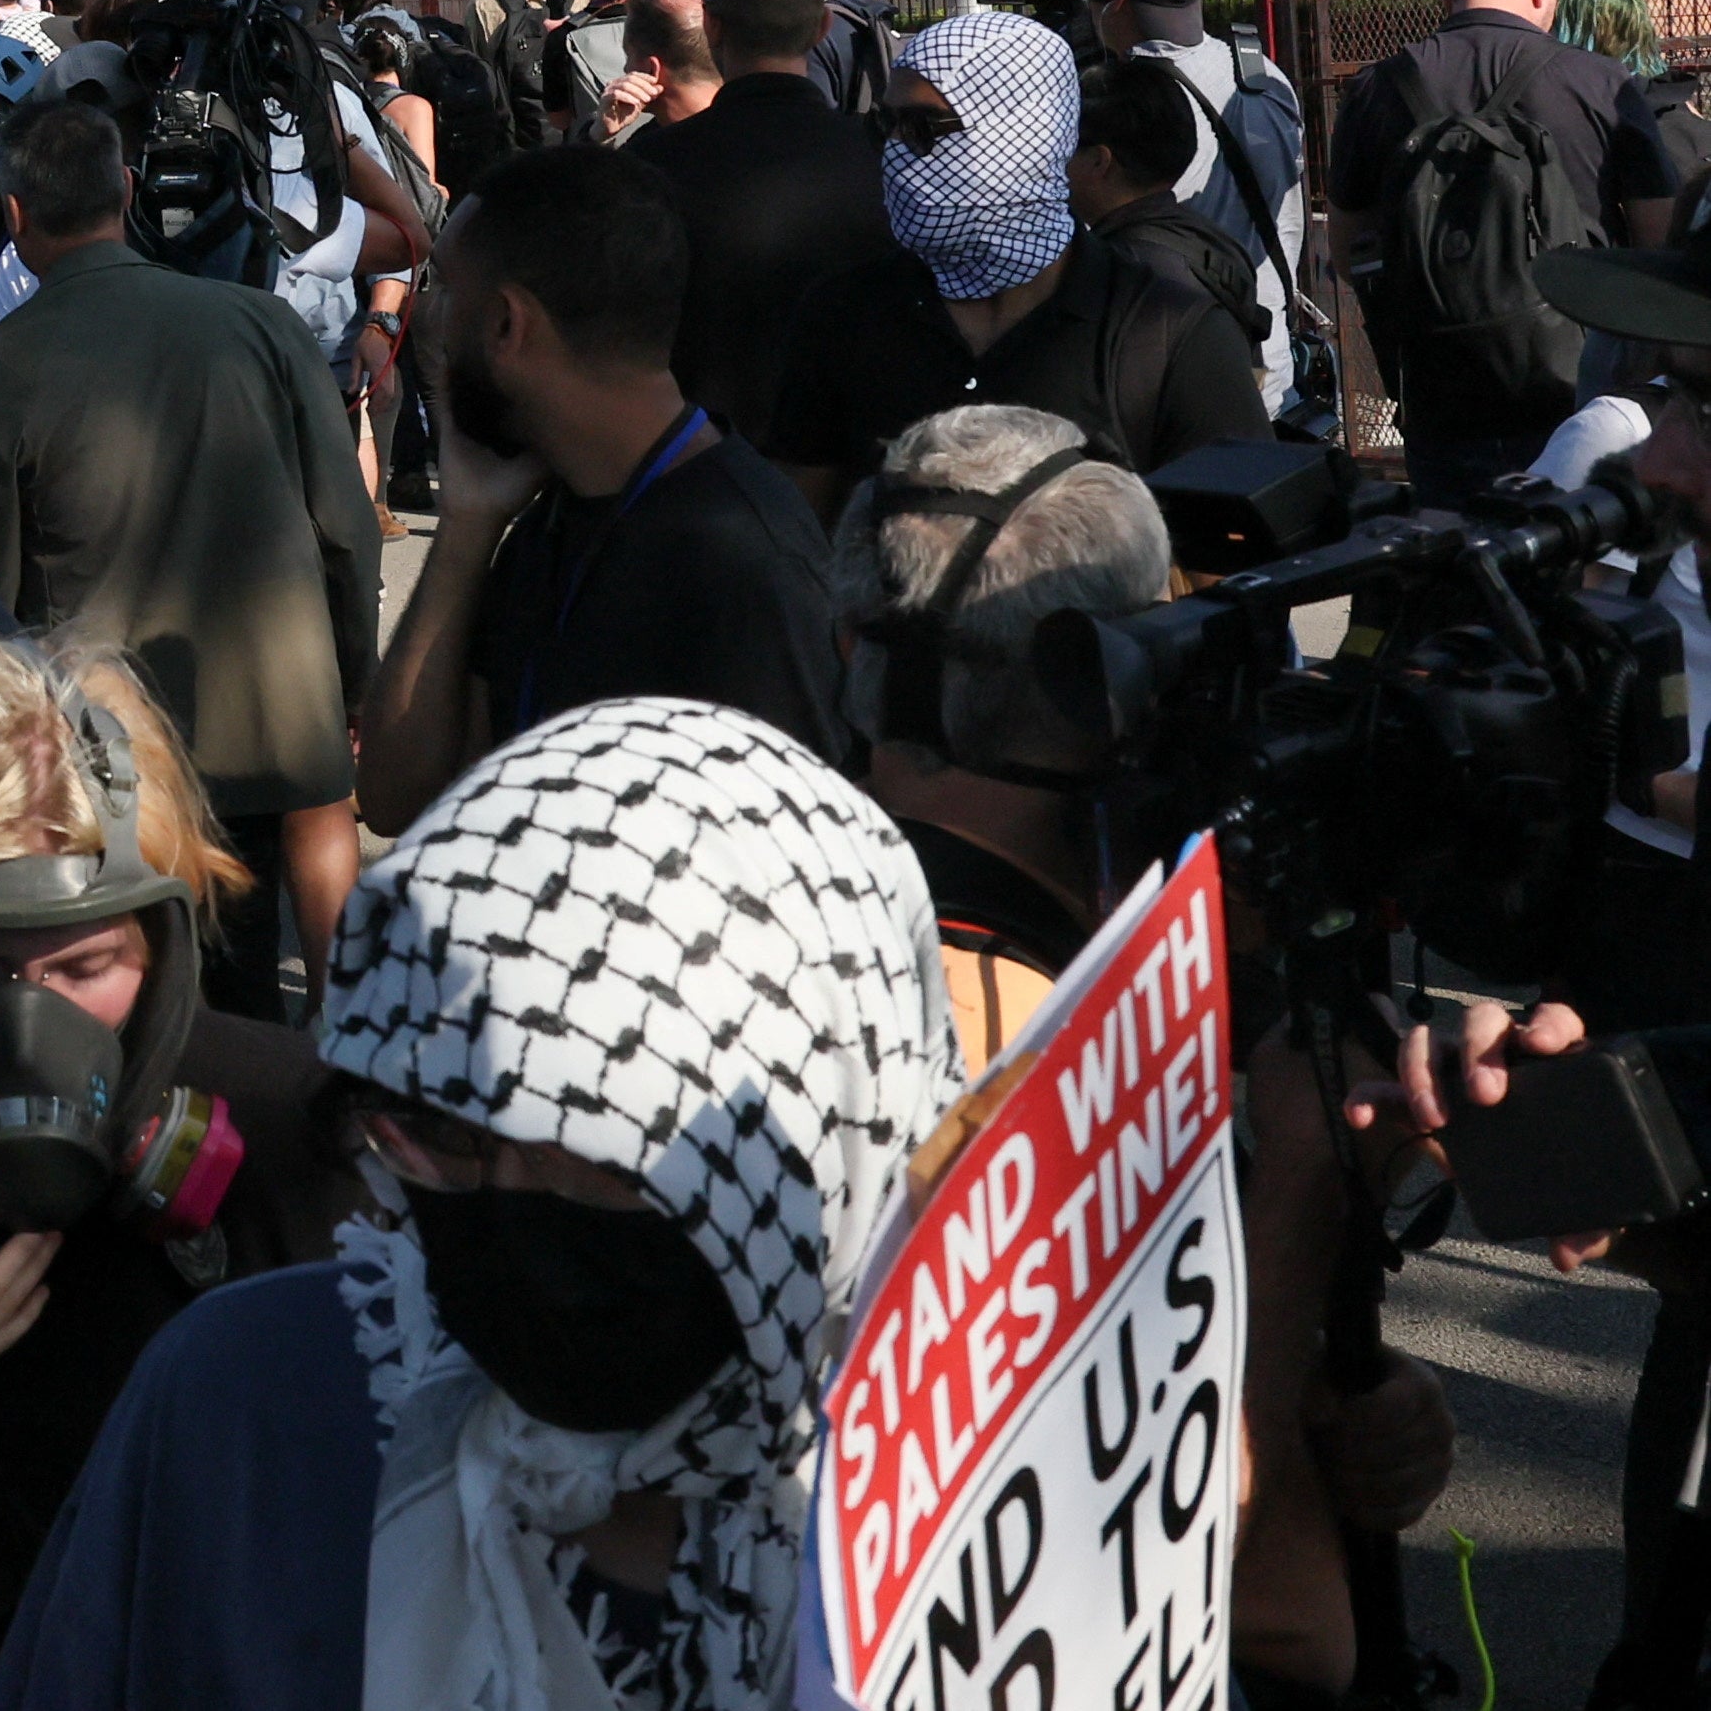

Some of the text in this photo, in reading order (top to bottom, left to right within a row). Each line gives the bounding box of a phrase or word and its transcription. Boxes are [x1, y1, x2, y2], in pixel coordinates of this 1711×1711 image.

[841, 887, 1213, 1510] STAND WITH
[852, 1009, 1219, 1649] PALESTINE!
[1084, 1216, 1216, 1483] U.S
[1100, 1378, 1221, 1635] TO
